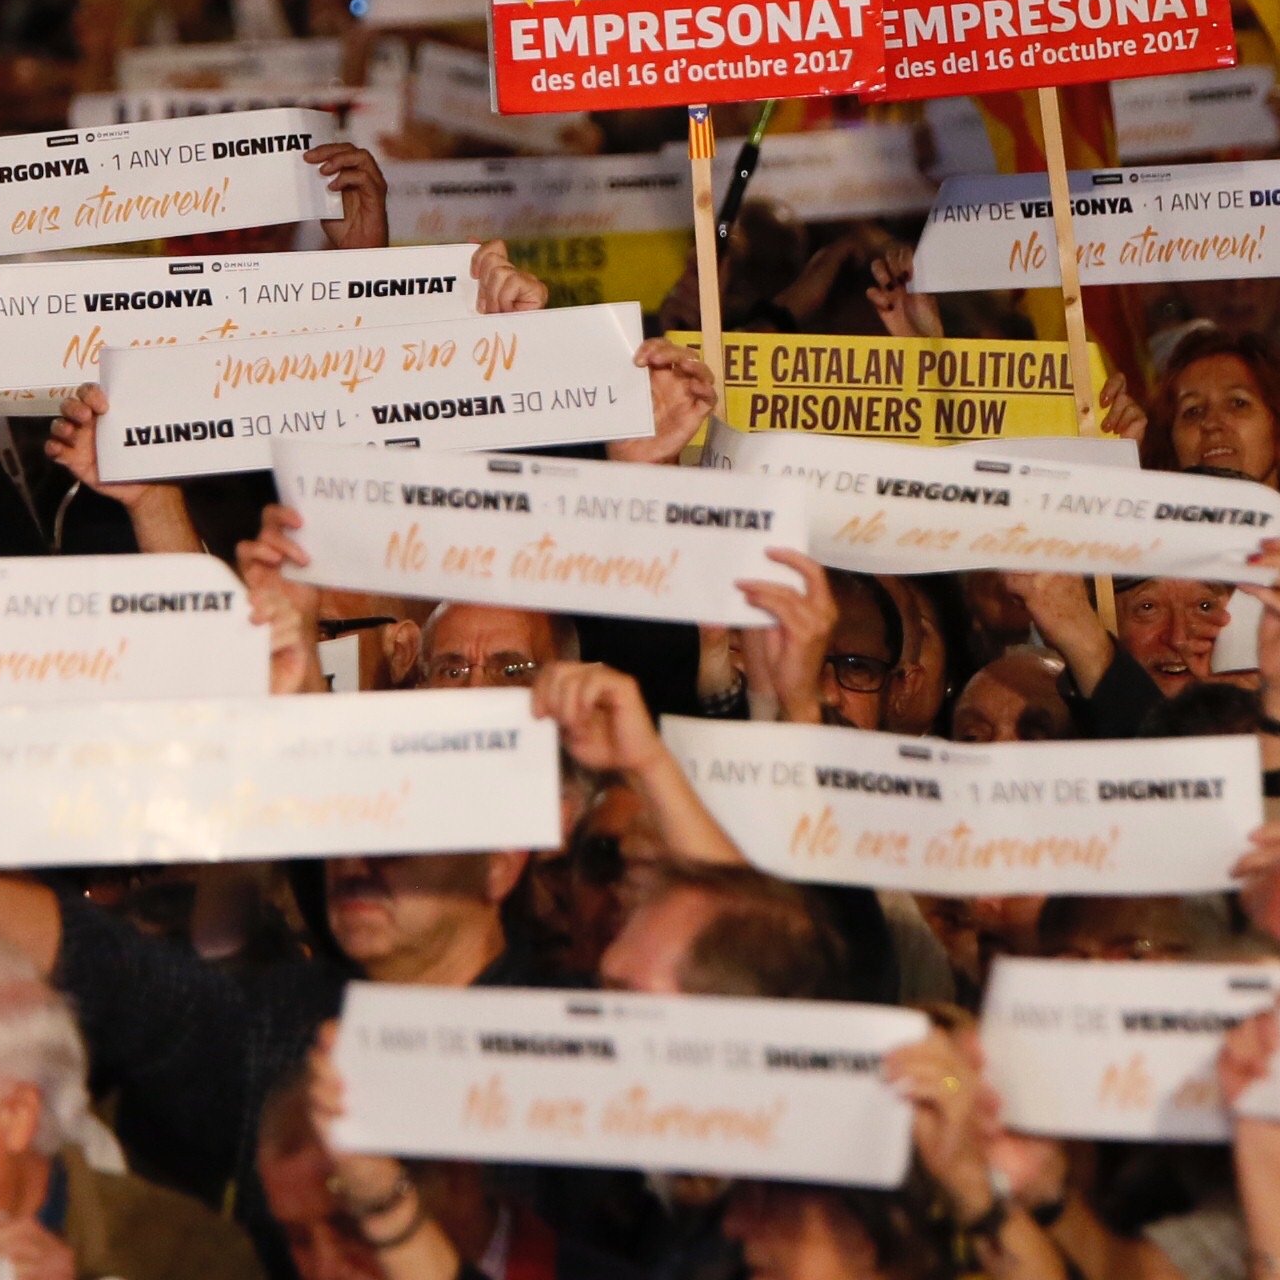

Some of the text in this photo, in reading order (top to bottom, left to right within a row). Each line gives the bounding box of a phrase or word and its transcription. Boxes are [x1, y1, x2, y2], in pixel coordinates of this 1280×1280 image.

[532, 69, 575, 92] des
[582, 64, 620, 89] del
[627, 63, 657, 85] 16
[794, 49, 852, 74] 2017
[895, 57, 936, 79] des
[942, 50, 978, 74] del
[985, 48, 1014, 70] 16
[1143, 28, 1199, 53] 2017
[112, 151, 120, 170] 1
[130, 147, 171, 169] ANY
[179, 143, 206, 163] DE
[213, 134, 316, 164] DIGNITAT
[10, 206, 61, 233] ens
[944, 202, 982, 222] ANY
[989, 202, 1015, 220] DE
[1020, 198, 1133, 218] VEONYA
[1155, 195, 1162, 212] 1
[1171, 192, 1211, 211] ANY
[1218, 190, 1244, 209] DE
[1009, 231, 1044, 272] No
[1076, 242, 1106, 267] ns
[402, 344, 457, 372] ens
[477, 336, 518, 382] No
[724, 345, 1074, 390] EE CATALAN POLITICAL
[124, 384, 617, 446] 1 ANY DE VERGONYA 1 ANY DE DIGNITAT
[749, 394, 1006, 435] PRISONERS NOW
[816, 768, 1221, 802] VERGONYA DIGNITAT
